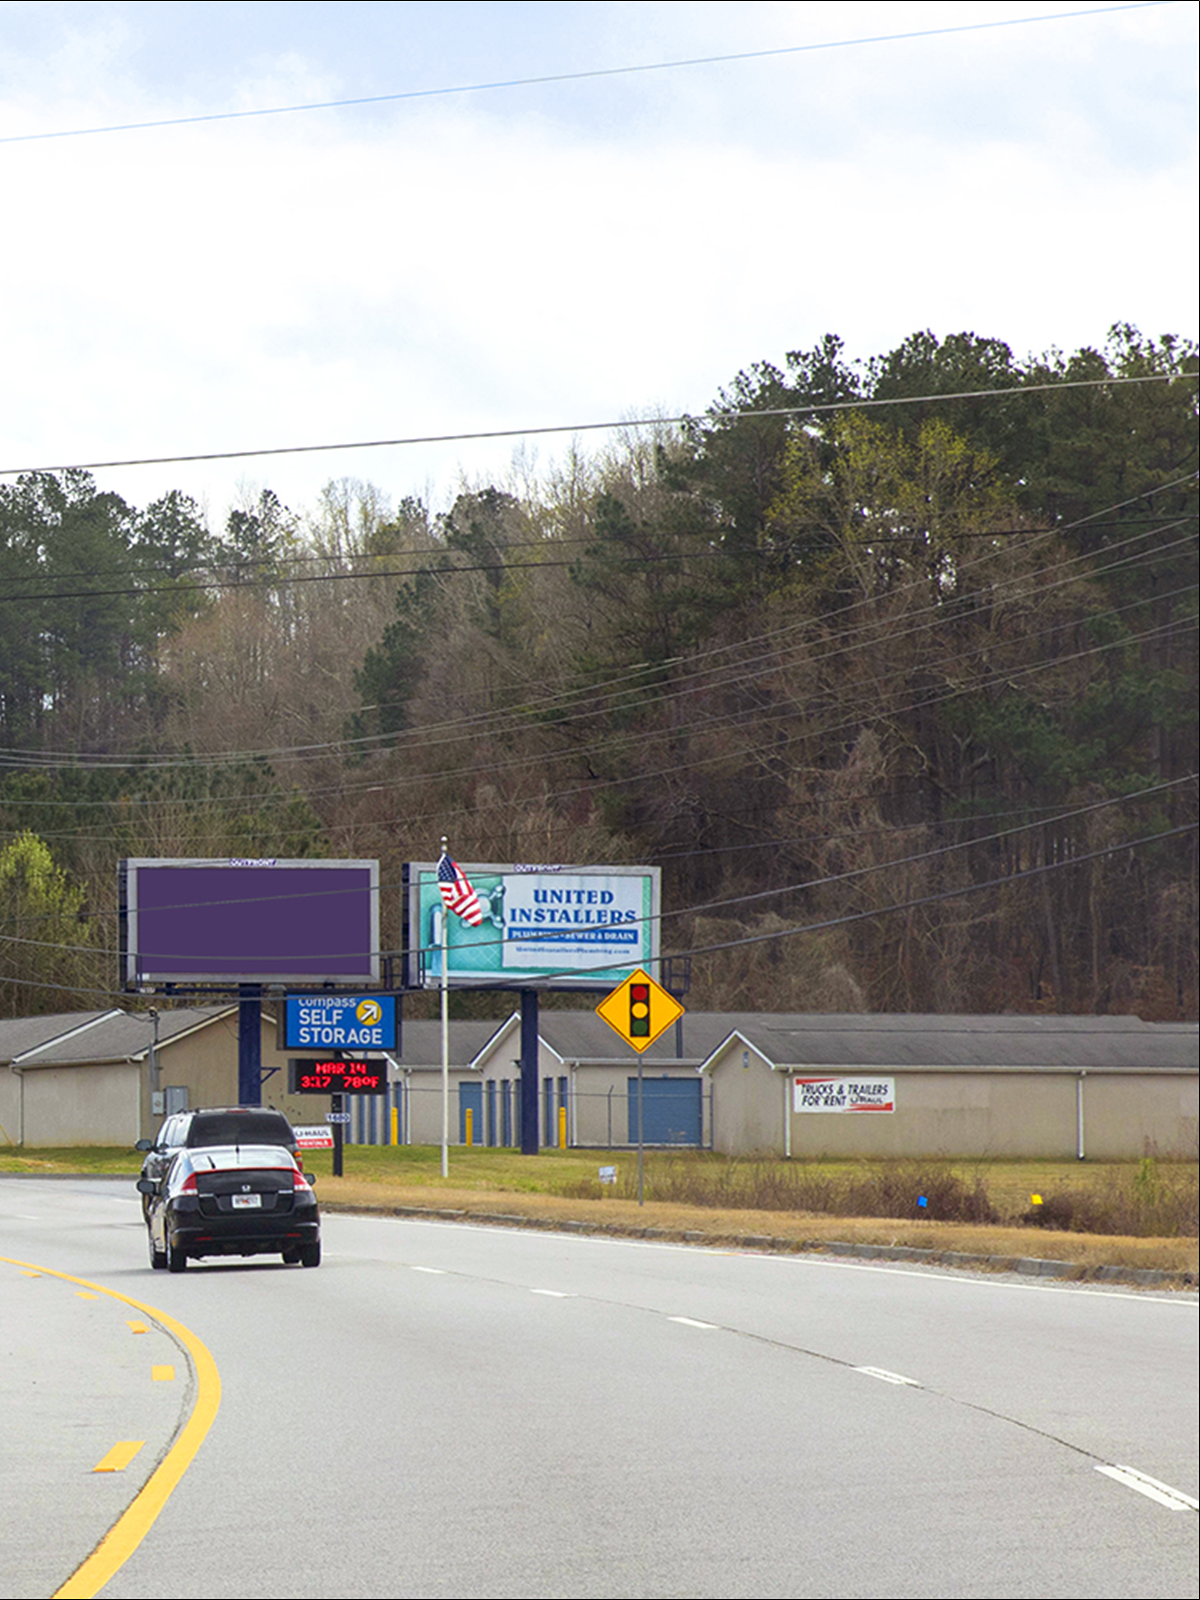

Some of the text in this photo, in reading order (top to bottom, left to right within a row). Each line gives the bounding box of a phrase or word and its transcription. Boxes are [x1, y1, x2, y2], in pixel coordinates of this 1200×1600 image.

[533, 889, 613, 904] UNITED
[509, 908, 638, 924] INSTALLERS
[564, 931, 596, 940] SEWER
[604, 932, 636, 941] DRAIN
[298, 997, 357, 1010] compass
[299, 1008, 344, 1026] SELF
[299, 1027, 383, 1045] STORAGE
[315, 1062, 367, 1075] MAR 14
[301, 1075, 332, 1088] 3:17
[801, 1083, 889, 1096] TRUCKS & TRAILERS
[801, 1095, 820, 1106] FOR
[823, 1095, 847, 1106] RENT
